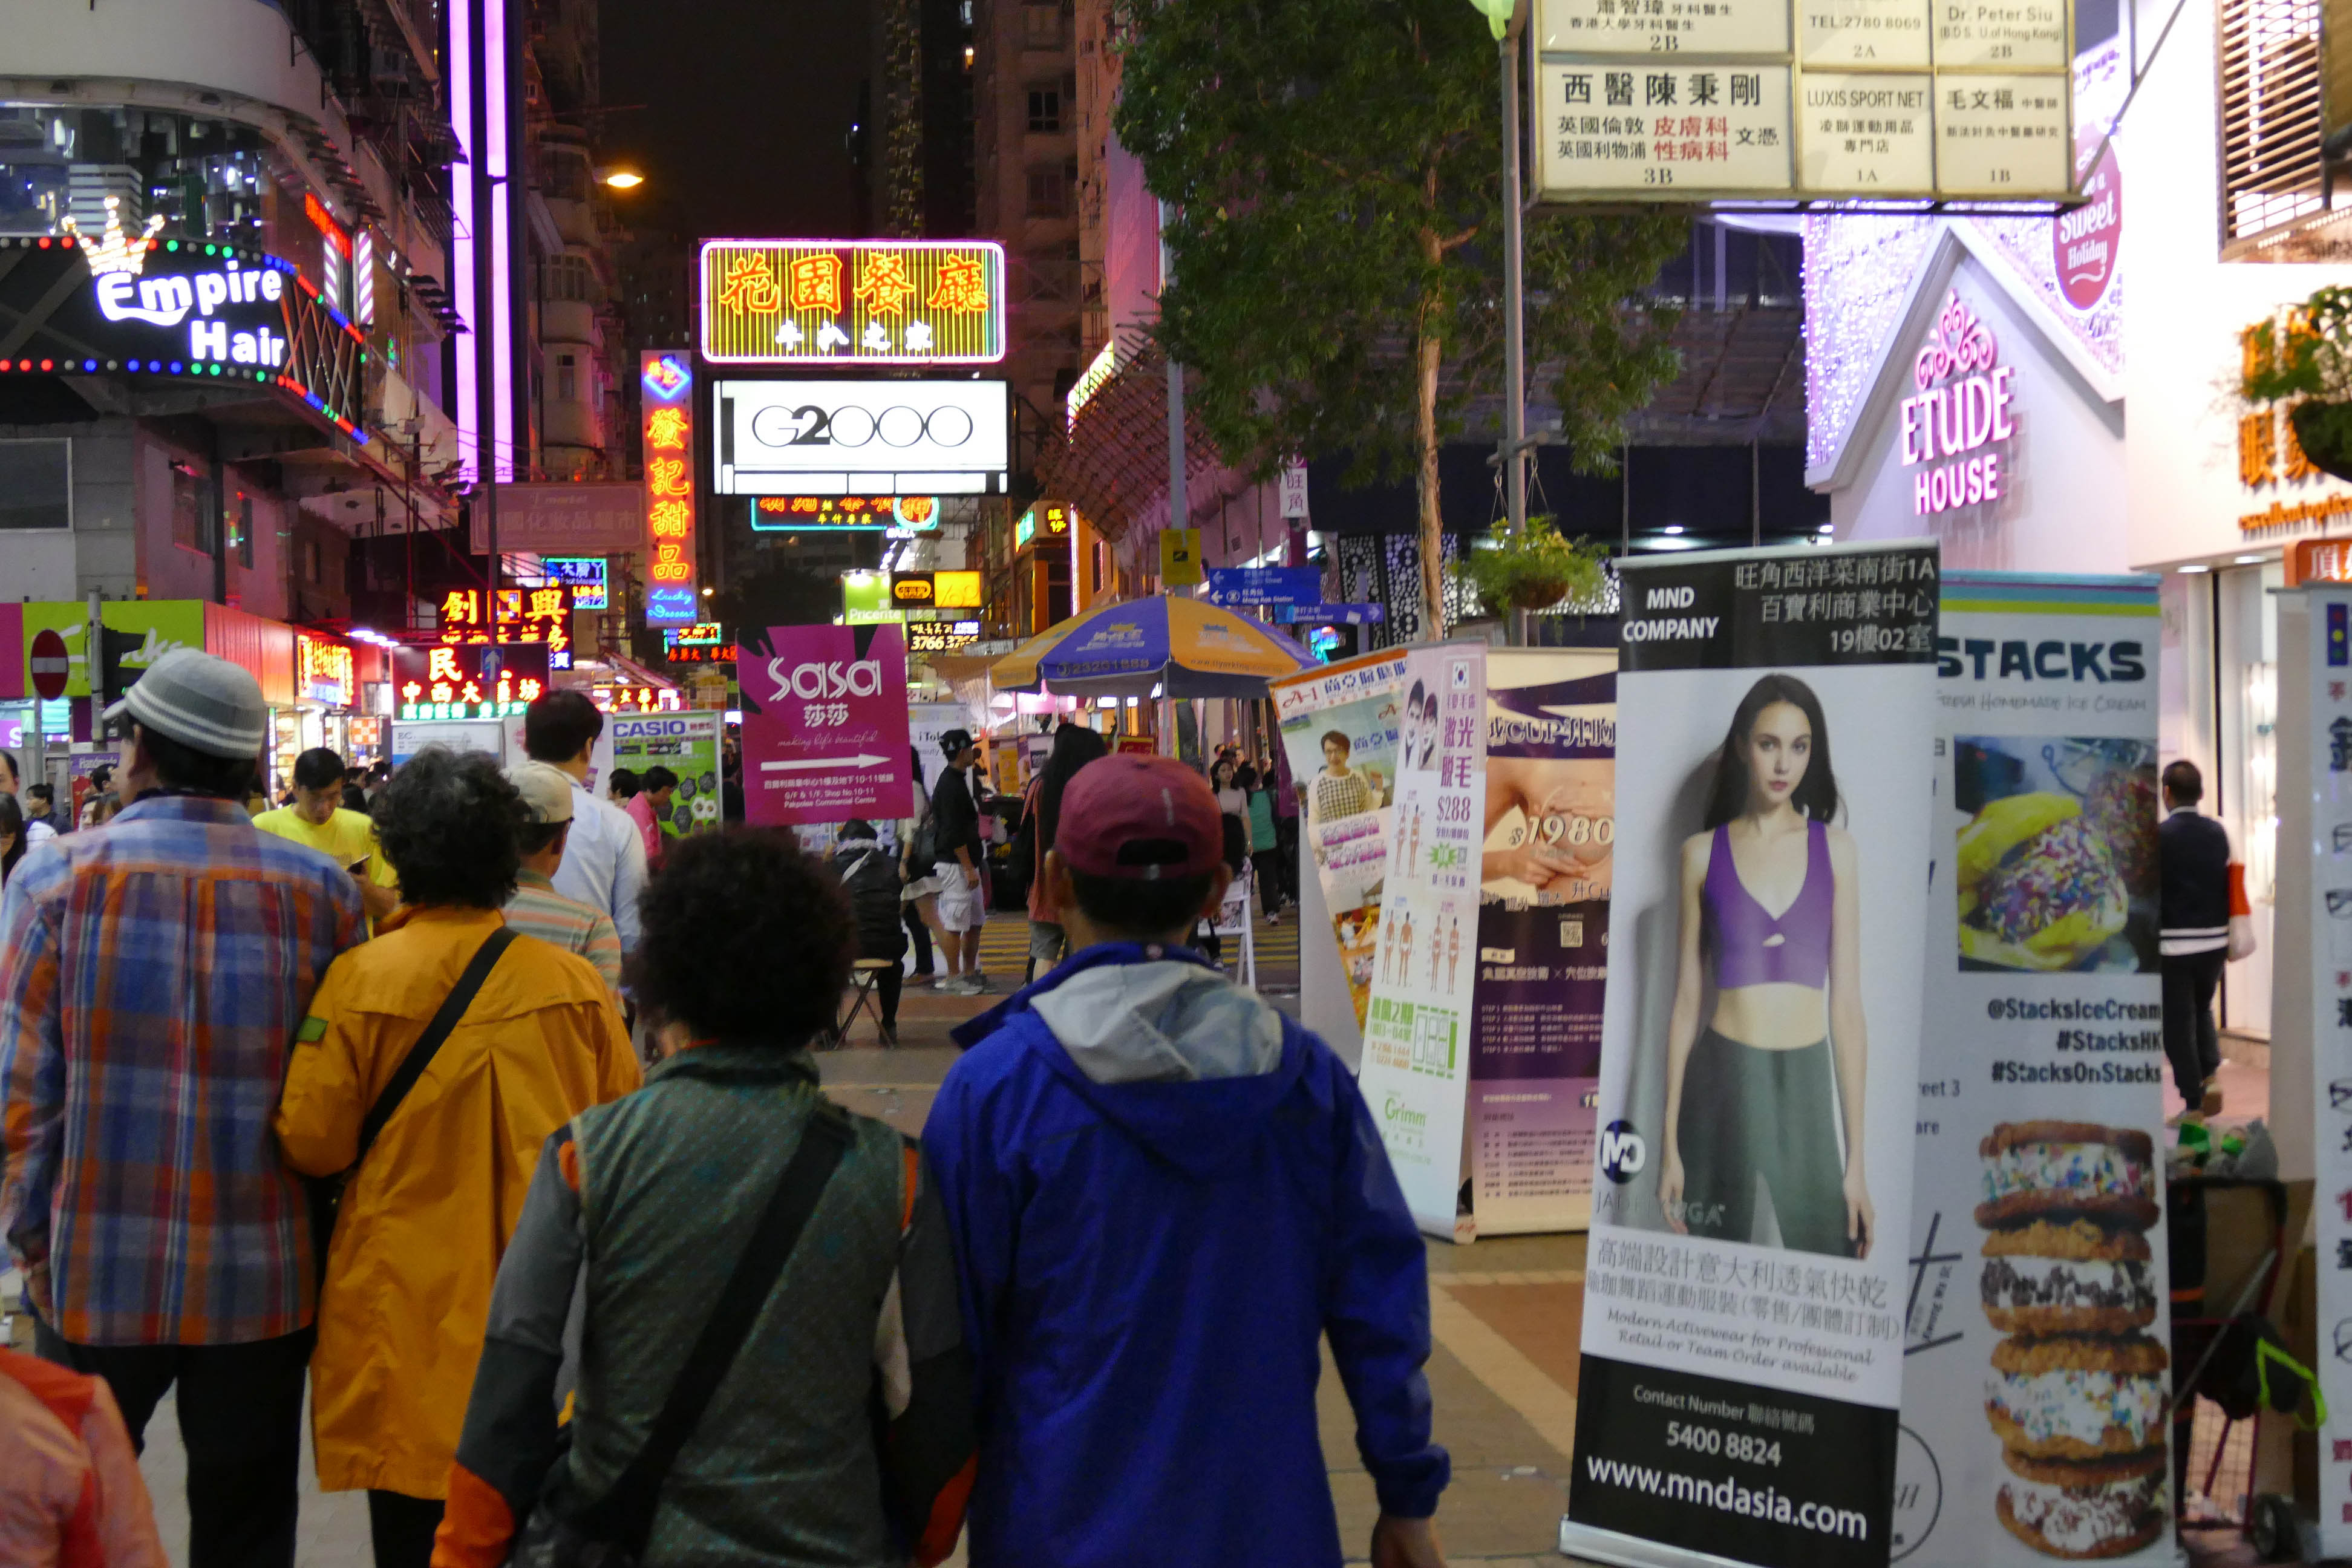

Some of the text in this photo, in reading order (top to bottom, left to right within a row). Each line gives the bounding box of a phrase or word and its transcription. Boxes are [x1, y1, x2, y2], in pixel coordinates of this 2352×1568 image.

[1570, 18, 1694, 31] 香港大學牙科醫生
[1886, 16, 1921, 30] 8069
[1949, 6, 2053, 22] Dr. Peter Siu
[1650, 35, 1679, 51] 2B
[1854, 45, 1876, 59] 2A
[1991, 45, 2013, 59] 2B
[1562, 72, 1761, 107] 西醫陳秉剛
[1808, 90, 1924, 109] LUXIS SPORT NET
[1947, 89, 2014, 111] 毛文福
[1558, 116, 1729, 137] 英國倫敦 皮膚科
[1558, 140, 1729, 162] 英國利物浦 性病科
[1644, 168, 1673, 185] 3B
[1858, 169, 1878, 182] 1A
[1990, 169, 2011, 182] 1B
[2060, 195, 2118, 244] Sweet
[2067, 239, 2108, 270] Holiday
[97, 260, 283, 326] Empire
[719, 252, 990, 315] 花園餐廳
[190, 320, 284, 367] Hair
[752, 405, 973, 447] G2000
[1901, 367, 2013, 466] ETUDE
[647, 408, 690, 580] 發記甜品
[1915, 454, 1998, 515] HOUSE
[1735, 553, 1935, 590] 旺角西洋菜南街1A
[651, 589, 693, 604] Lucky
[1647, 586, 1695, 610] MND
[1762, 588, 1933, 624] 百寶利商業中心
[849, 607, 901, 621] Pricerite
[910, 635, 944, 650] 3766
[1622, 616, 1719, 642] COMPANY
[1938, 635, 2146, 684] STACKS
[613, 720, 685, 737] CASIO
[803, 703, 849, 727] 莎莎
[1445, 716, 1474, 748] 激光
[1437, 795, 1471, 823] $288
[2057, 1028, 2162, 1051] #StacksHK
[1385, 1096, 1426, 1127] Grimm
[1607, 1307, 1873, 1365] Modern Activewear for Professional
[1619, 1329, 1857, 1383] Retail or Team Order available
[1634, 1384, 1686, 1410] Contact
[1689, 1396, 1745, 1422] Number
[1667, 1420, 1782, 1468] 5400 8824
[1587, 1455, 1867, 1541] www.mndasia.com
